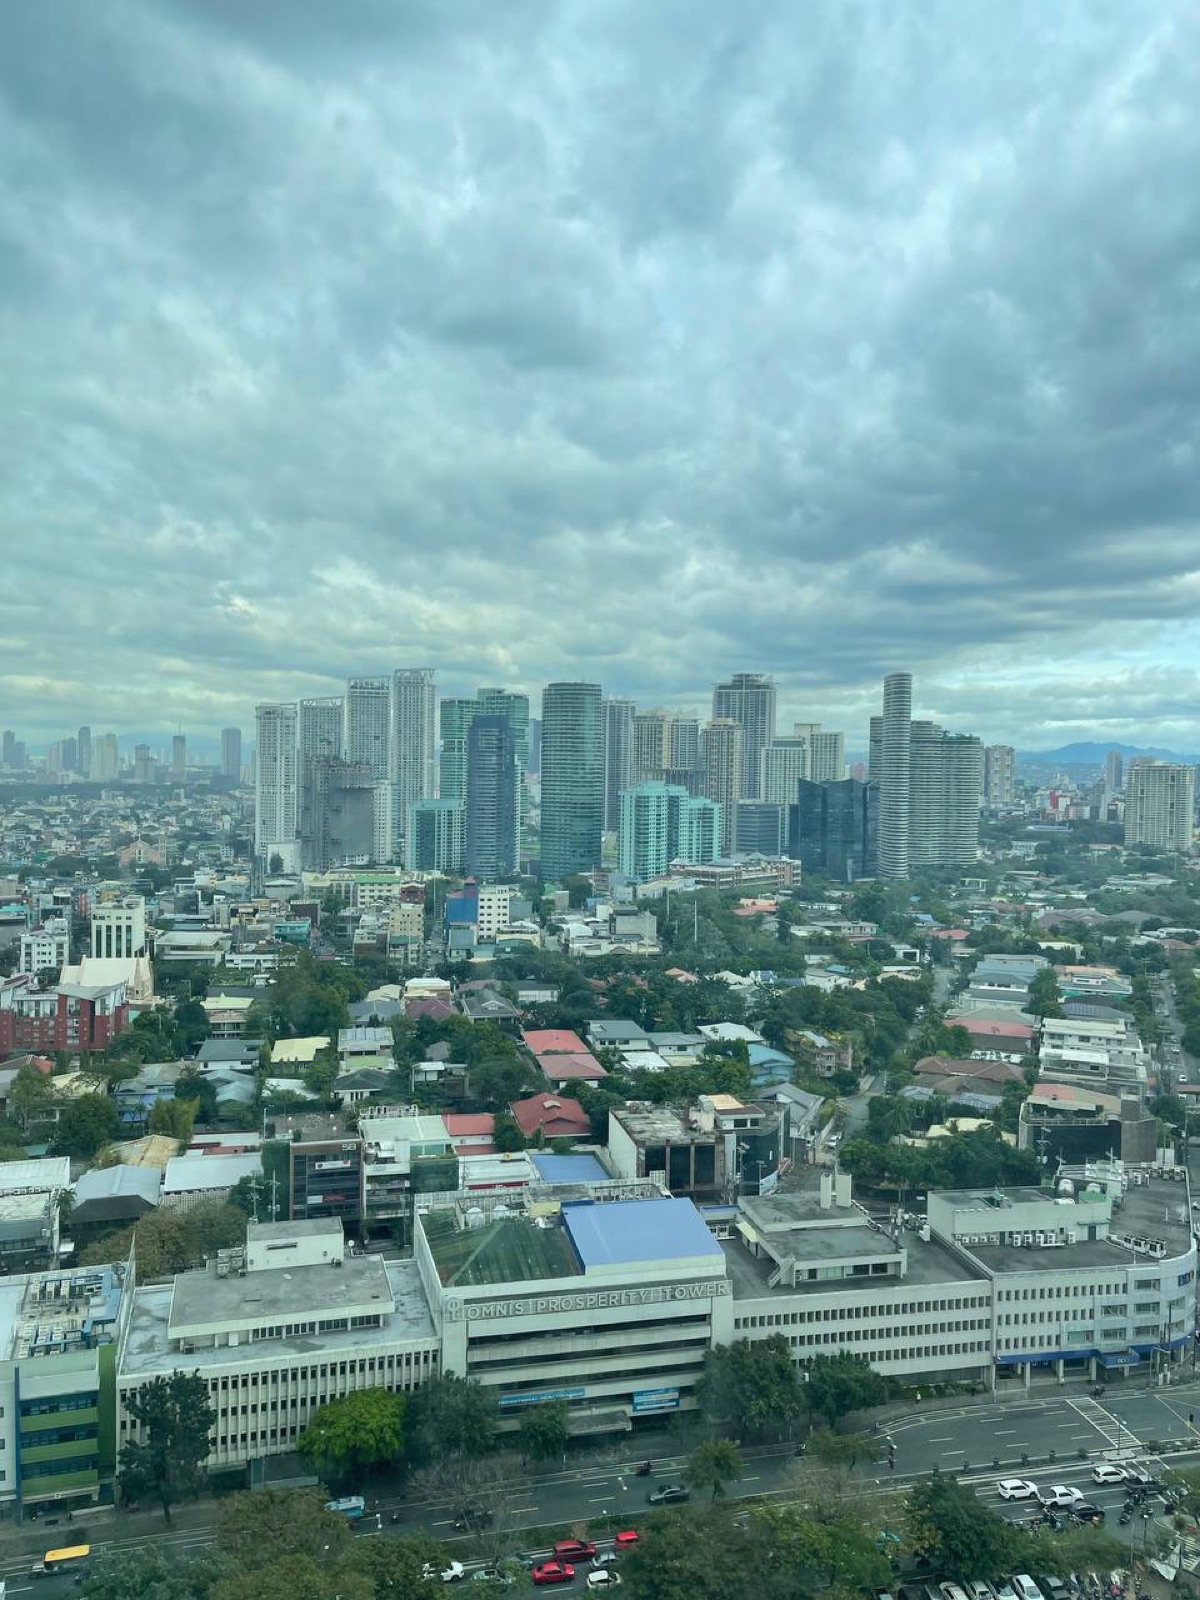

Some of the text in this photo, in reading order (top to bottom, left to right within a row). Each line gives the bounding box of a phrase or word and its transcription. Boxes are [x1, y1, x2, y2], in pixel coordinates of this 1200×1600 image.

[468, 1284, 727, 1318] OMNIS PROSPERITY TOWER
